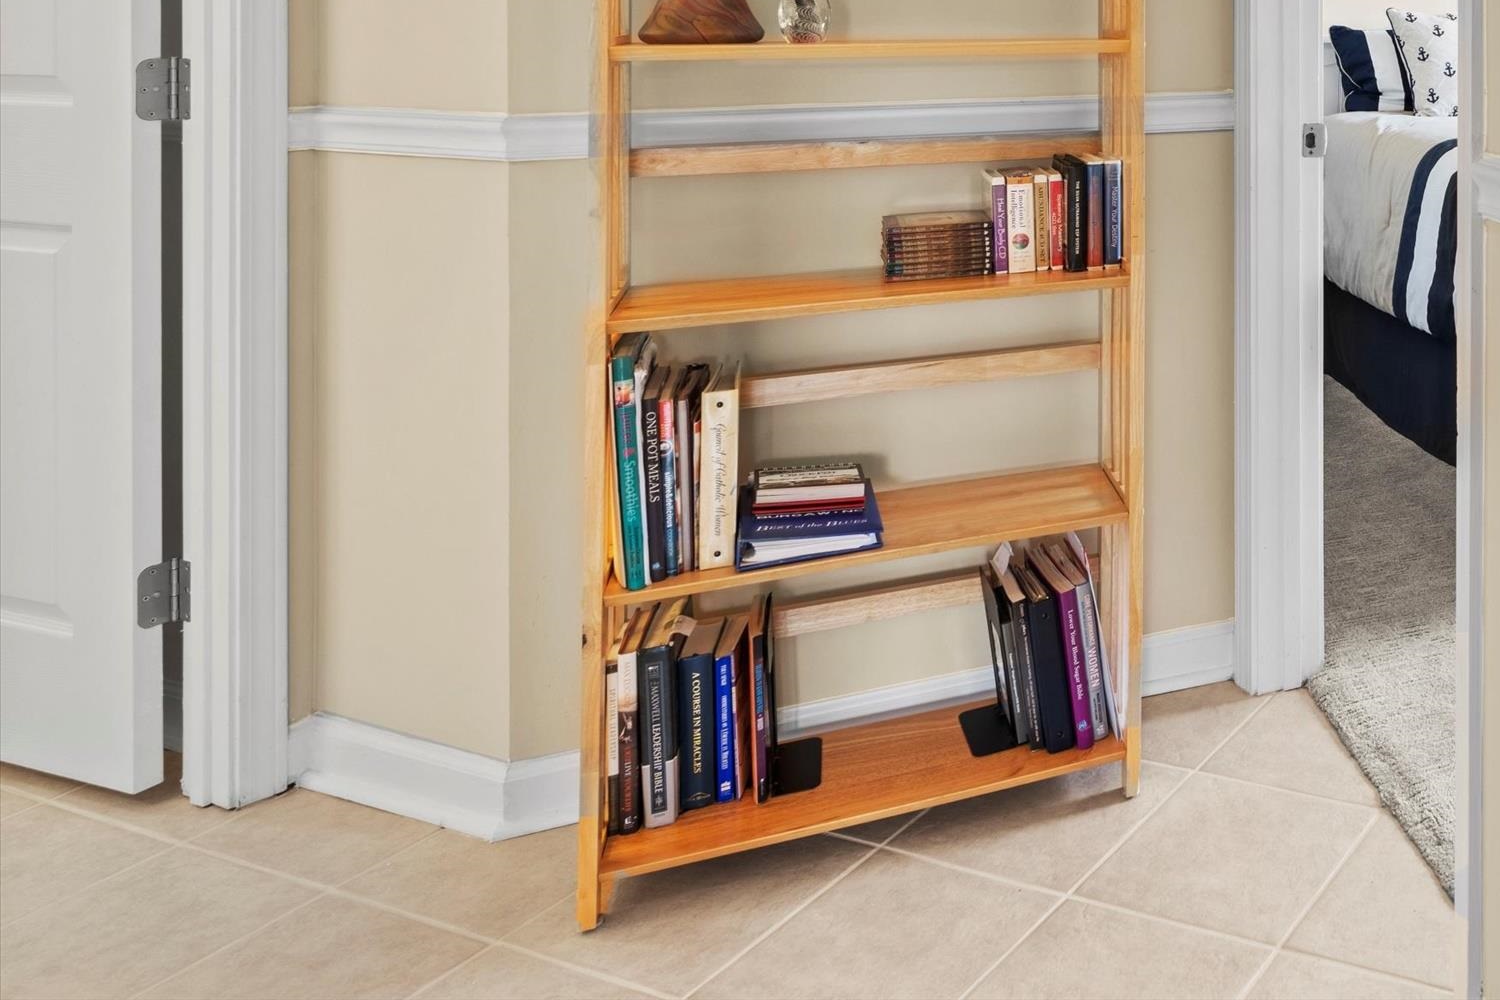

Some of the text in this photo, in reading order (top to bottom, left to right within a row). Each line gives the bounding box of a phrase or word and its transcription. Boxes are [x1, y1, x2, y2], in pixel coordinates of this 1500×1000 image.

[1009, 189, 1018, 230] Intelligence
[1018, 189, 1026, 228] Emotional
[1038, 186, 1046, 233] ABUNDANCE
[999, 246, 1007, 259] CD
[1110, 224, 1118, 248] Destiny
[645, 410, 660, 503] ONE POT MEALS
[622, 460, 638, 523] Smoothies
[711, 422, 729, 537] Council of Catholic Women
[1067, 609, 1083, 701] Lower Your Blood Sugar Bible
[1087, 647, 1101, 688] WOMEN
[652, 686, 662, 724] MAXWELL
[692, 680, 702, 717] COURSE
[692, 717, 702, 728] IN
[652, 724, 663, 771] LEADERSHIP
[692, 728, 703, 774] MIRACLES
[654, 772, 664, 794] BIBLE
